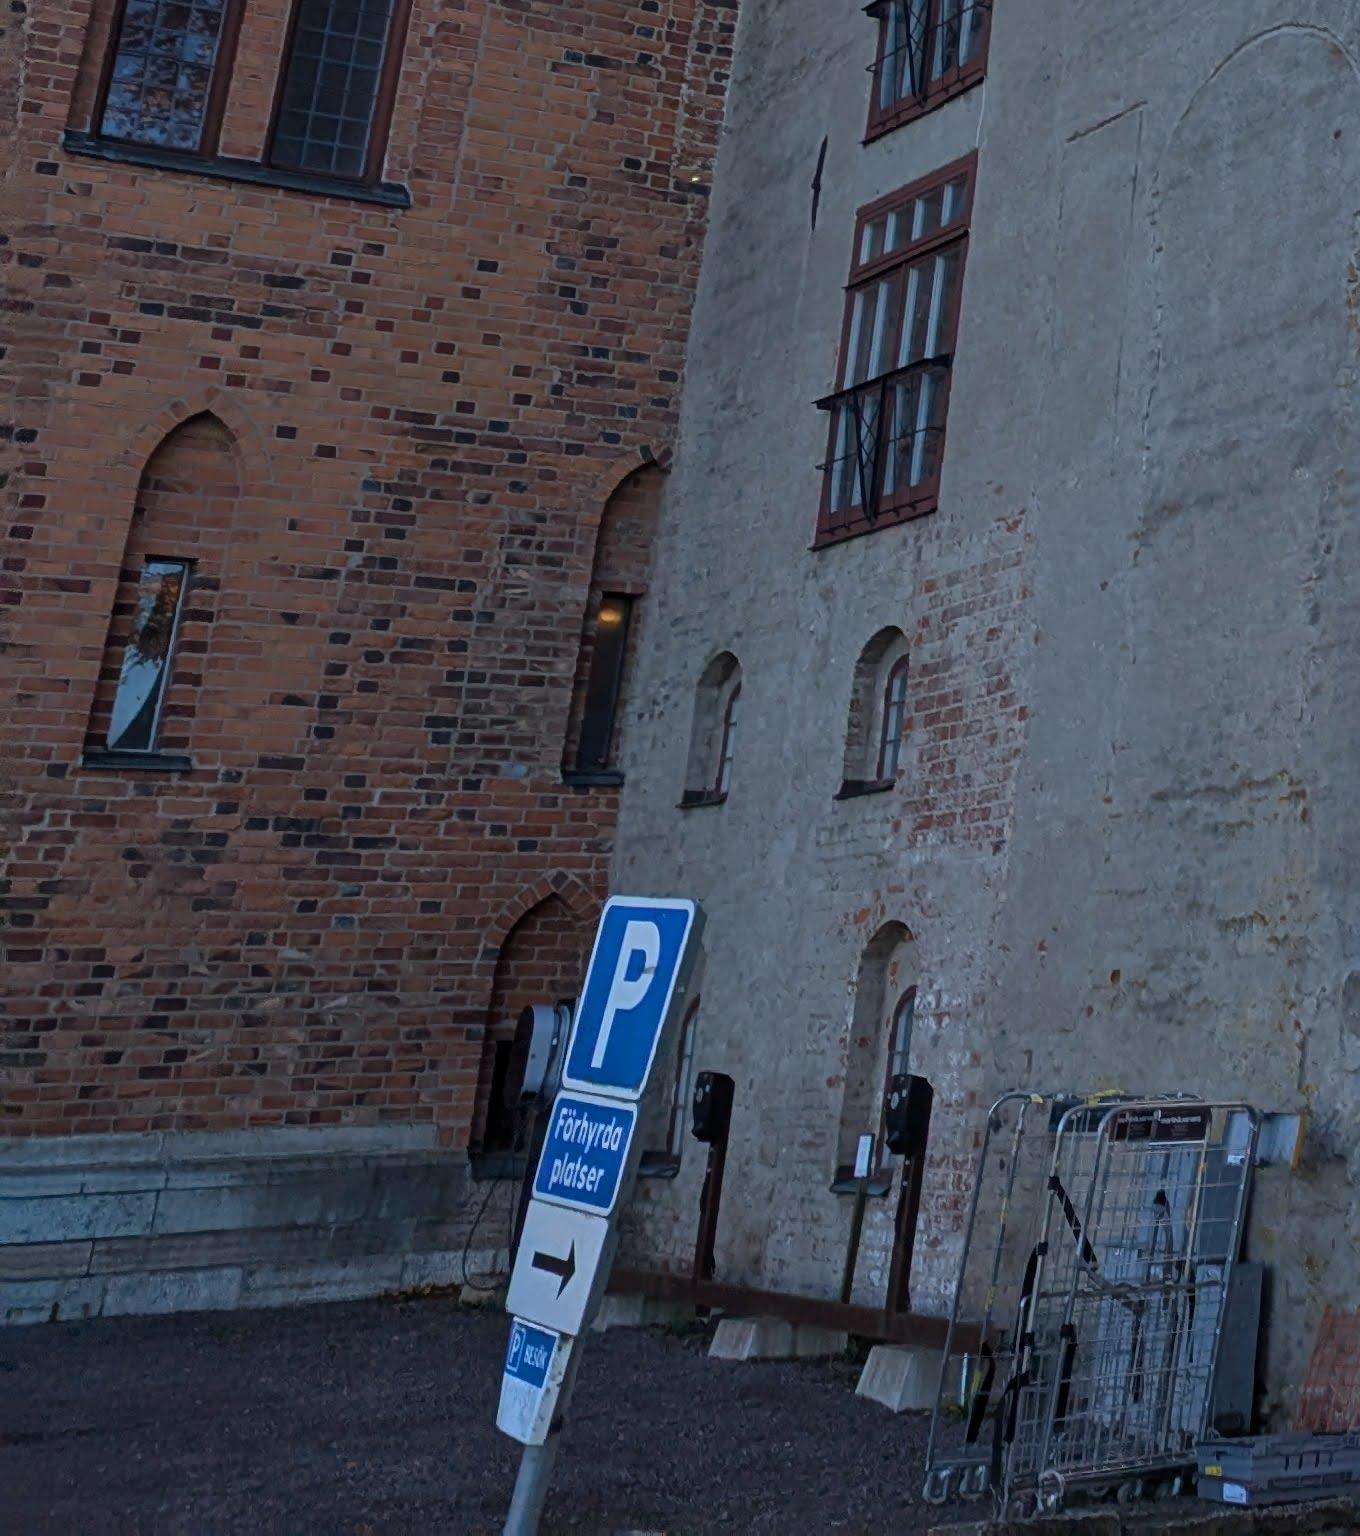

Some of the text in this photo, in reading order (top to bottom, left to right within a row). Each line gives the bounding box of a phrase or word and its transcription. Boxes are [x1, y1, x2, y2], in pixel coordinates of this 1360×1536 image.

[591, 920, 660, 1068] P
[554, 1107, 623, 1154] Förhyrda
[548, 1152, 605, 1193] platser
